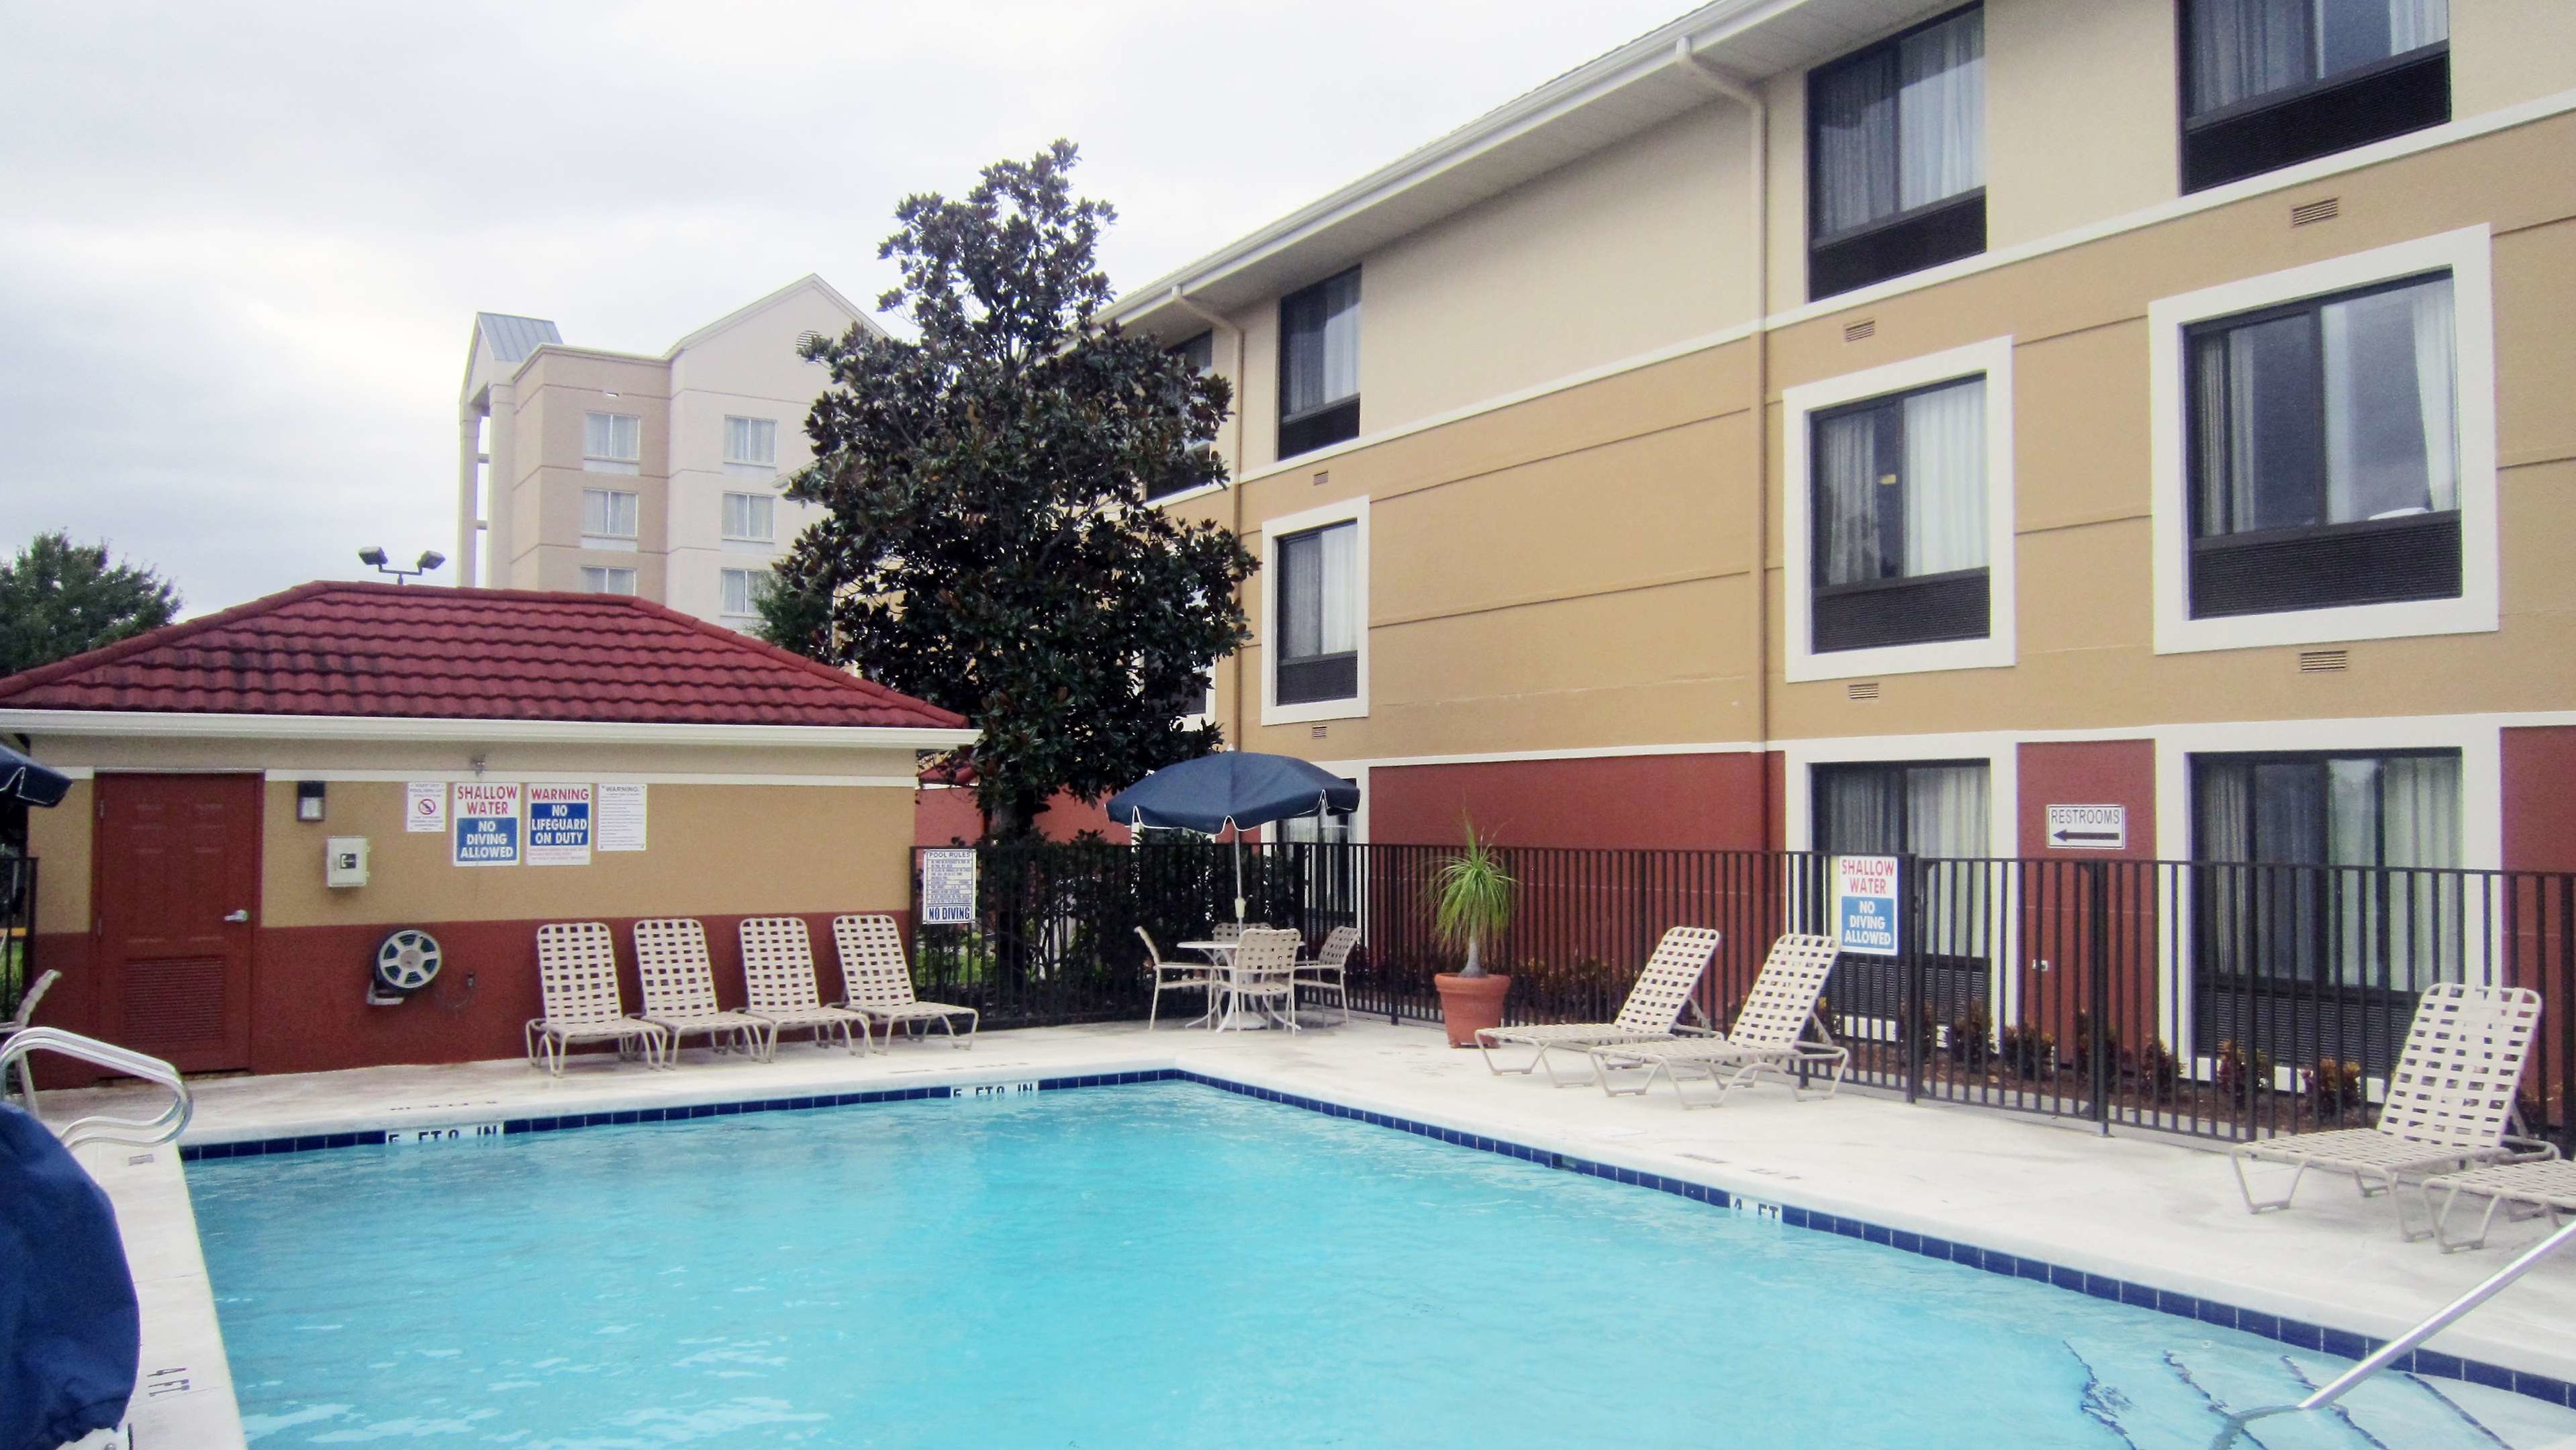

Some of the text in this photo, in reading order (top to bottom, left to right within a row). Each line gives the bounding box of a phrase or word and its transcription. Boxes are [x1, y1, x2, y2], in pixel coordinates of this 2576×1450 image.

[458, 786, 517, 800] SHALLOW
[532, 789, 589, 800] WARNING
[467, 802, 508, 814] WATER
[552, 805, 567, 816] NO
[2051, 810, 2119, 824] RESTROOMS
[479, 820, 495, 832] NO
[532, 819, 587, 830] LIFEGUARD
[467, 834, 508, 844] DIVING
[535, 832, 583, 844] ON DUTY
[461, 847, 513, 858] ALLOWED
[1842, 860, 1894, 876] SHALLOW
[1850, 878, 1886, 893] WATER
[1860, 901, 1875, 914] NO
[929, 908, 970, 920] NO DIVING
[1850, 916, 1885, 929] DIVING
[1845, 930, 1891, 945] ALLOWED
[148, 1380, 189, 1397] FT
